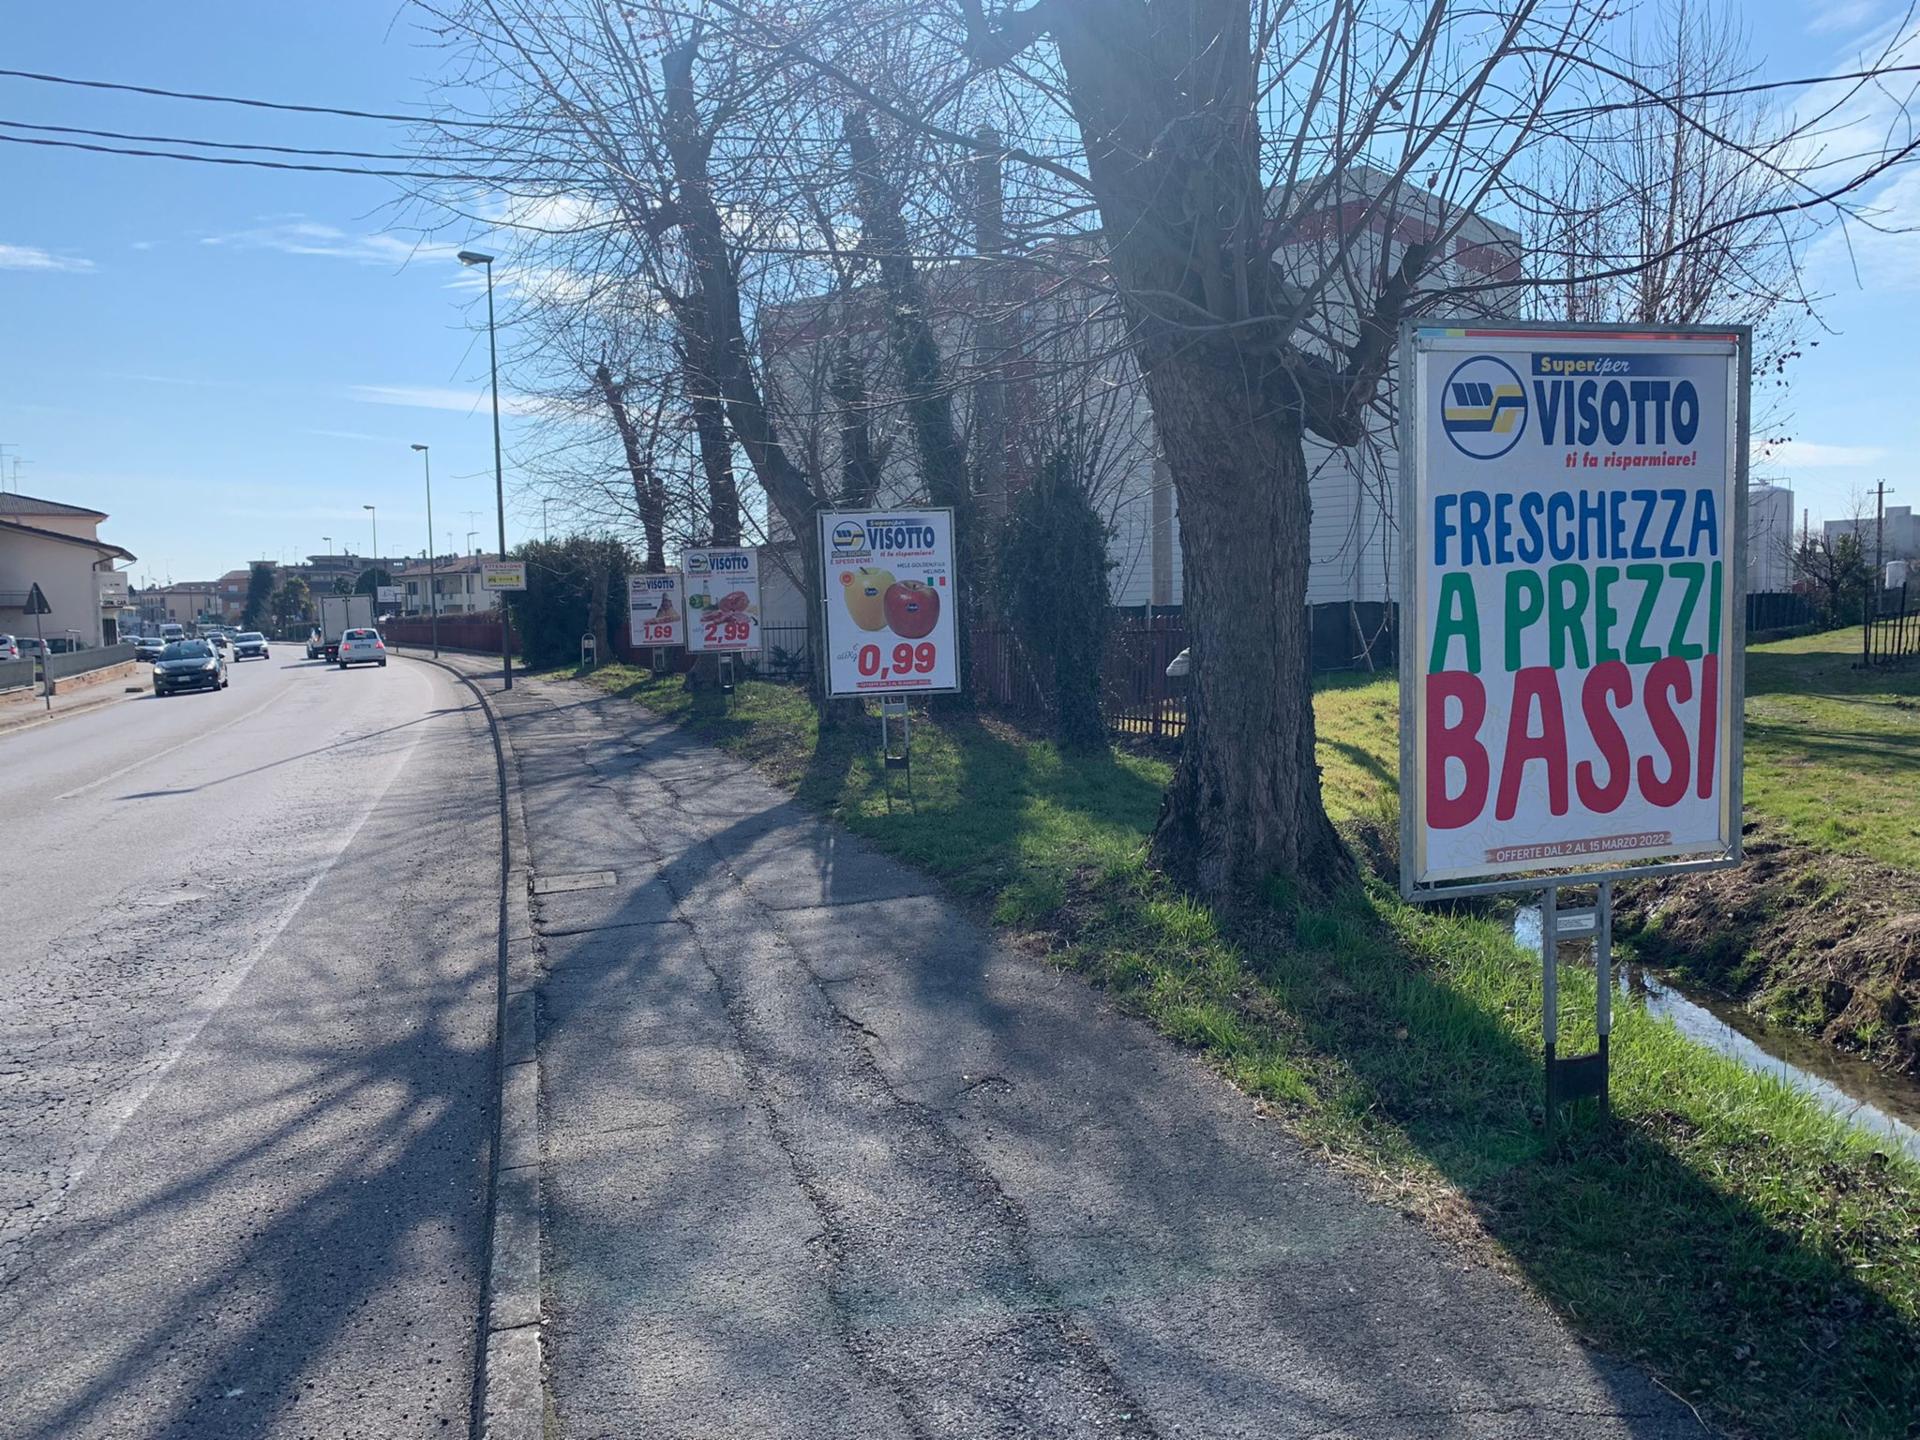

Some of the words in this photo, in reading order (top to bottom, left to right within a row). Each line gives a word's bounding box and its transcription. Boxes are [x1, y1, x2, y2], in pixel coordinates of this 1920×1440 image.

[1541, 357, 1630, 376] Superiper
[1533, 379, 1699, 446] VISOTTO
[1566, 452, 1576, 467] ti
[1583, 452, 1598, 467] fa
[1604, 451, 1697, 470] risparmiare!
[867, 526, 935, 550] VISOTTO
[1434, 489, 1718, 566] FRESCHEZZA
[709, 556, 749, 570] VISOTTO
[646, 579, 675, 590] VISOTTO
[1429, 571, 1481, 673] A
[1505, 560, 1722, 673] PREZZI
[643, 625, 672, 640] 1,69
[704, 622, 750, 643] 2,99
[858, 642, 936, 680] 0,99
[1426, 653, 1718, 829] BASSI
[1496, 848, 1542, 862] OFFERTE
[1544, 846, 1563, 857] DAL
[1566, 844, 1572, 854] 2
[1574, 843, 1587, 853] AL
[1589, 841, 1599, 852] 15
[1602, 837, 1637, 850] MARZO
[1639, 834, 1665, 847] 2022
